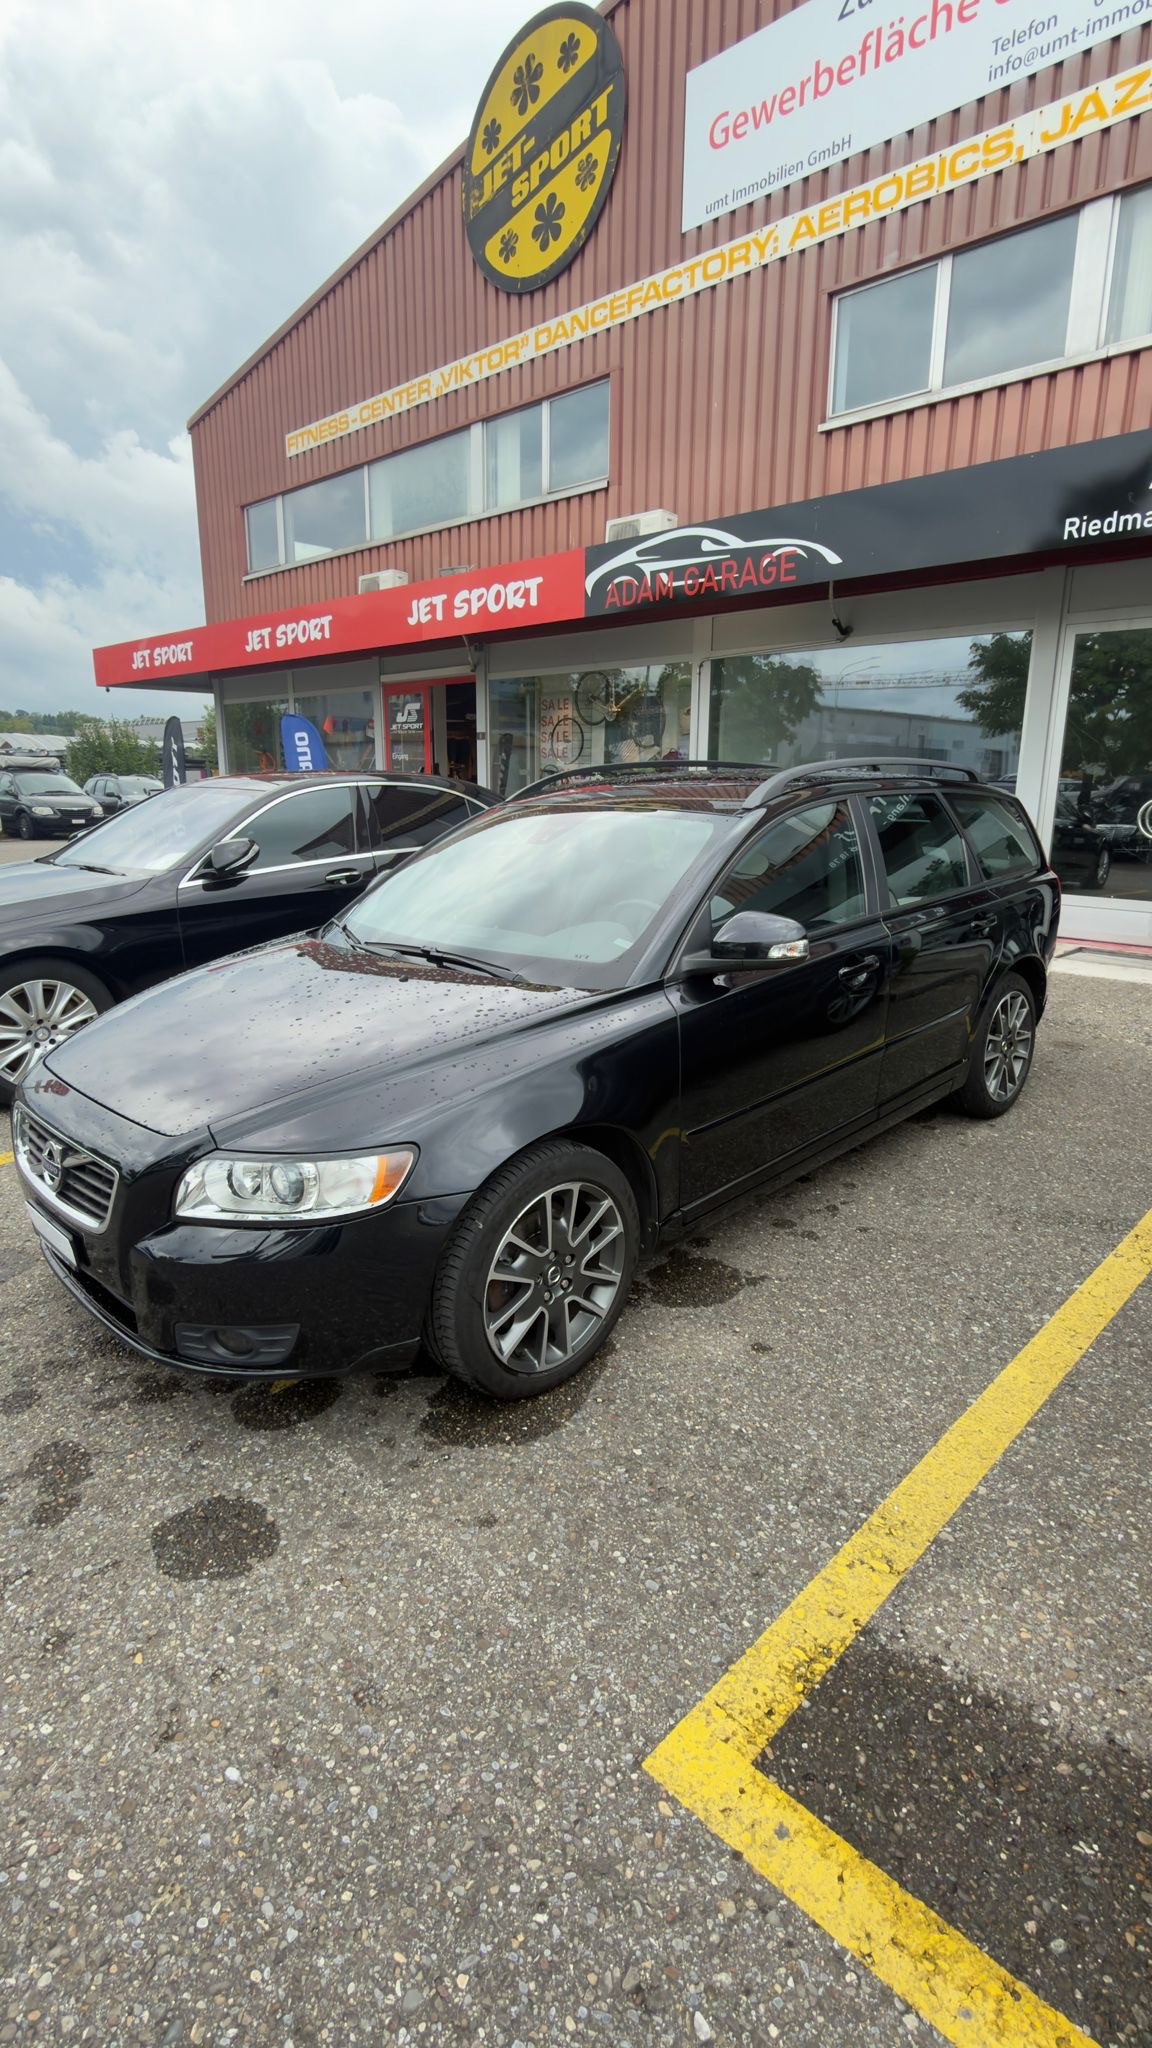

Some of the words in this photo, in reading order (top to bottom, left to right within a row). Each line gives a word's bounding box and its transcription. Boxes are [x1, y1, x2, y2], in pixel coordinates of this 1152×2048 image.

[992, 14, 1058, 56] Telefon
[709, 0, 981, 150] Gewerbefläche
[511, 84, 614, 208] SPORT
[705, 193, 729, 215] umt
[732, 160, 804, 203] Immobilien
[807, 134, 852, 167] GmbH
[534, 228, 779, 353] DANCEFACTORY:
[788, 127, 1024, 248] AEROBICS,
[1040, 68, 1152, 145] JAZ
[1063, 510, 1152, 540] Riedma
[604, 570, 674, 609] ADAM
[684, 549, 799, 596] GARAGE
[407, 594, 447, 625] JET
[453, 576, 544, 618] SPORT
[245, 627, 272, 653] JET
[276, 615, 333, 648] SPORT
[132, 648, 151, 670] JET
[153, 641, 194, 667] SPORT
[541, 698, 569, 711] SALE
[541, 714, 569, 727] SALE
[541, 731, 569, 743] SALE
[541, 747, 569, 759] SALE
